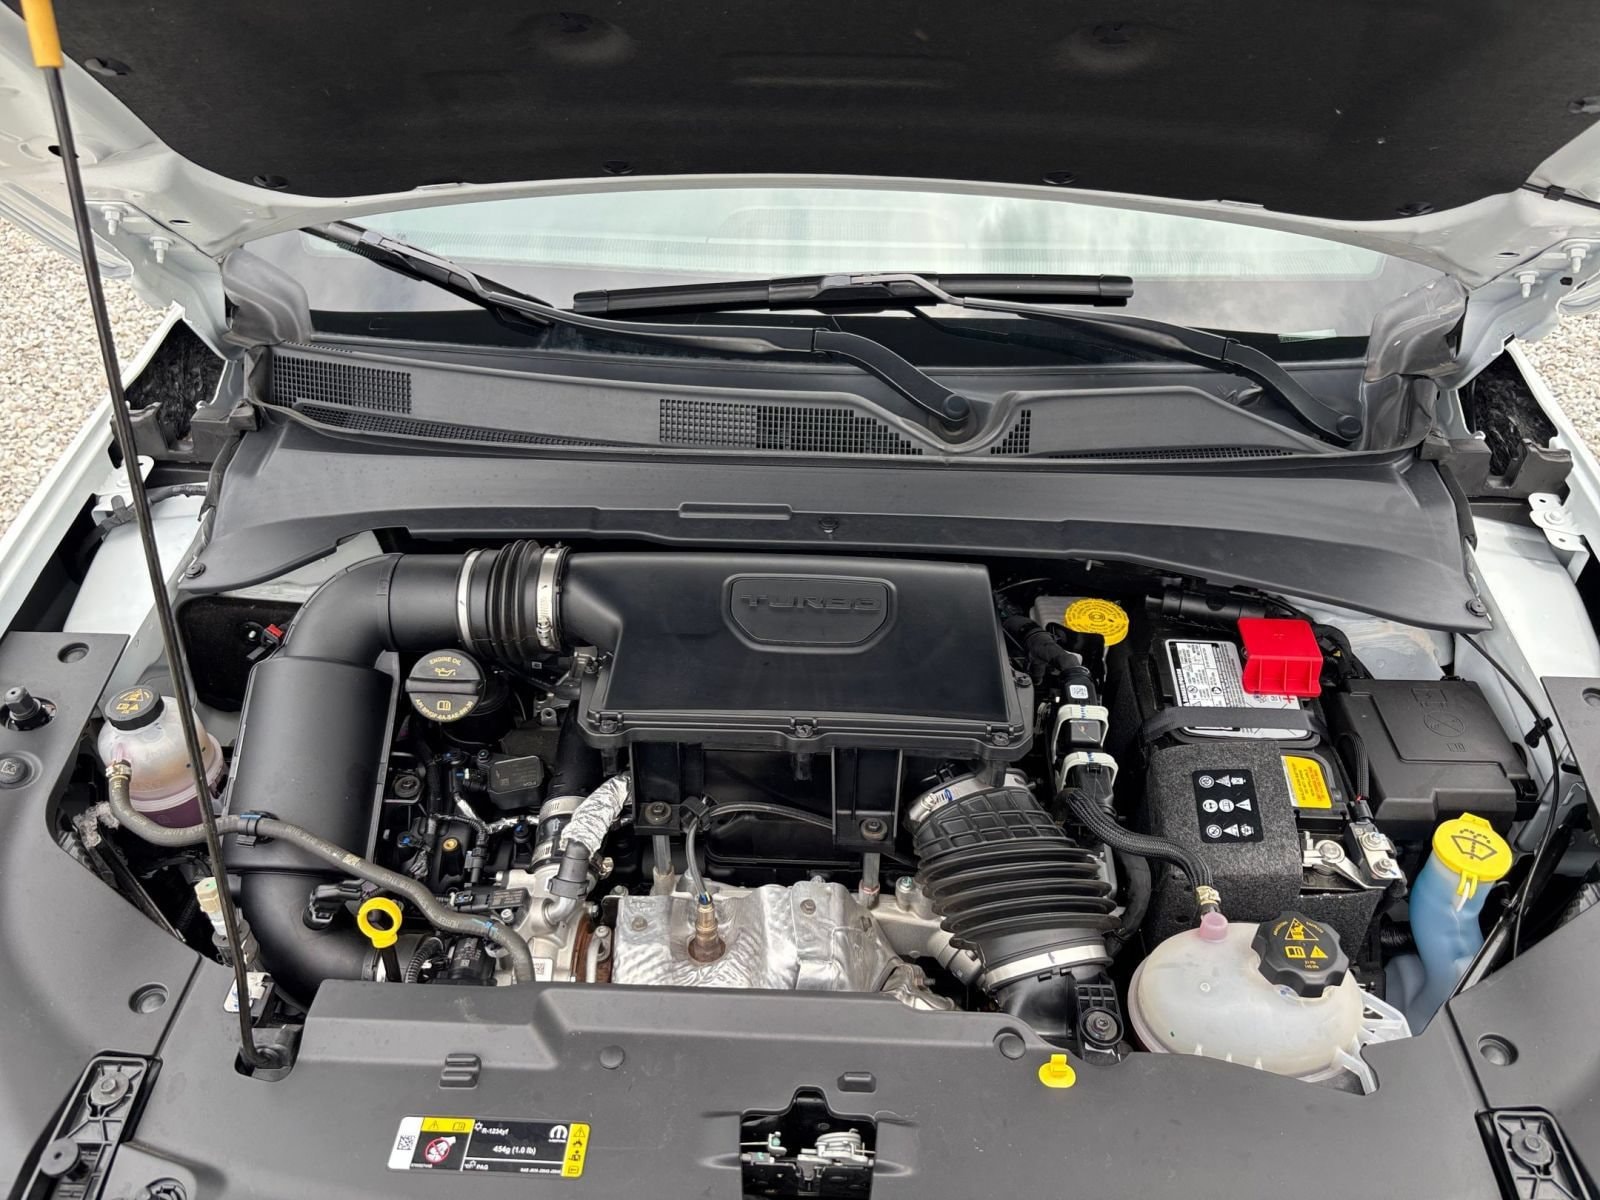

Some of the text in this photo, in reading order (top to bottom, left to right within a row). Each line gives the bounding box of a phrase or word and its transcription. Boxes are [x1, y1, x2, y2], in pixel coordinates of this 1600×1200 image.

[740, 594, 881, 612] TURBO
[429, 656, 462, 666] ENGINE OIL
[492, 1145, 511, 1155] 454g
[526, 1146, 537, 1156] lb)
